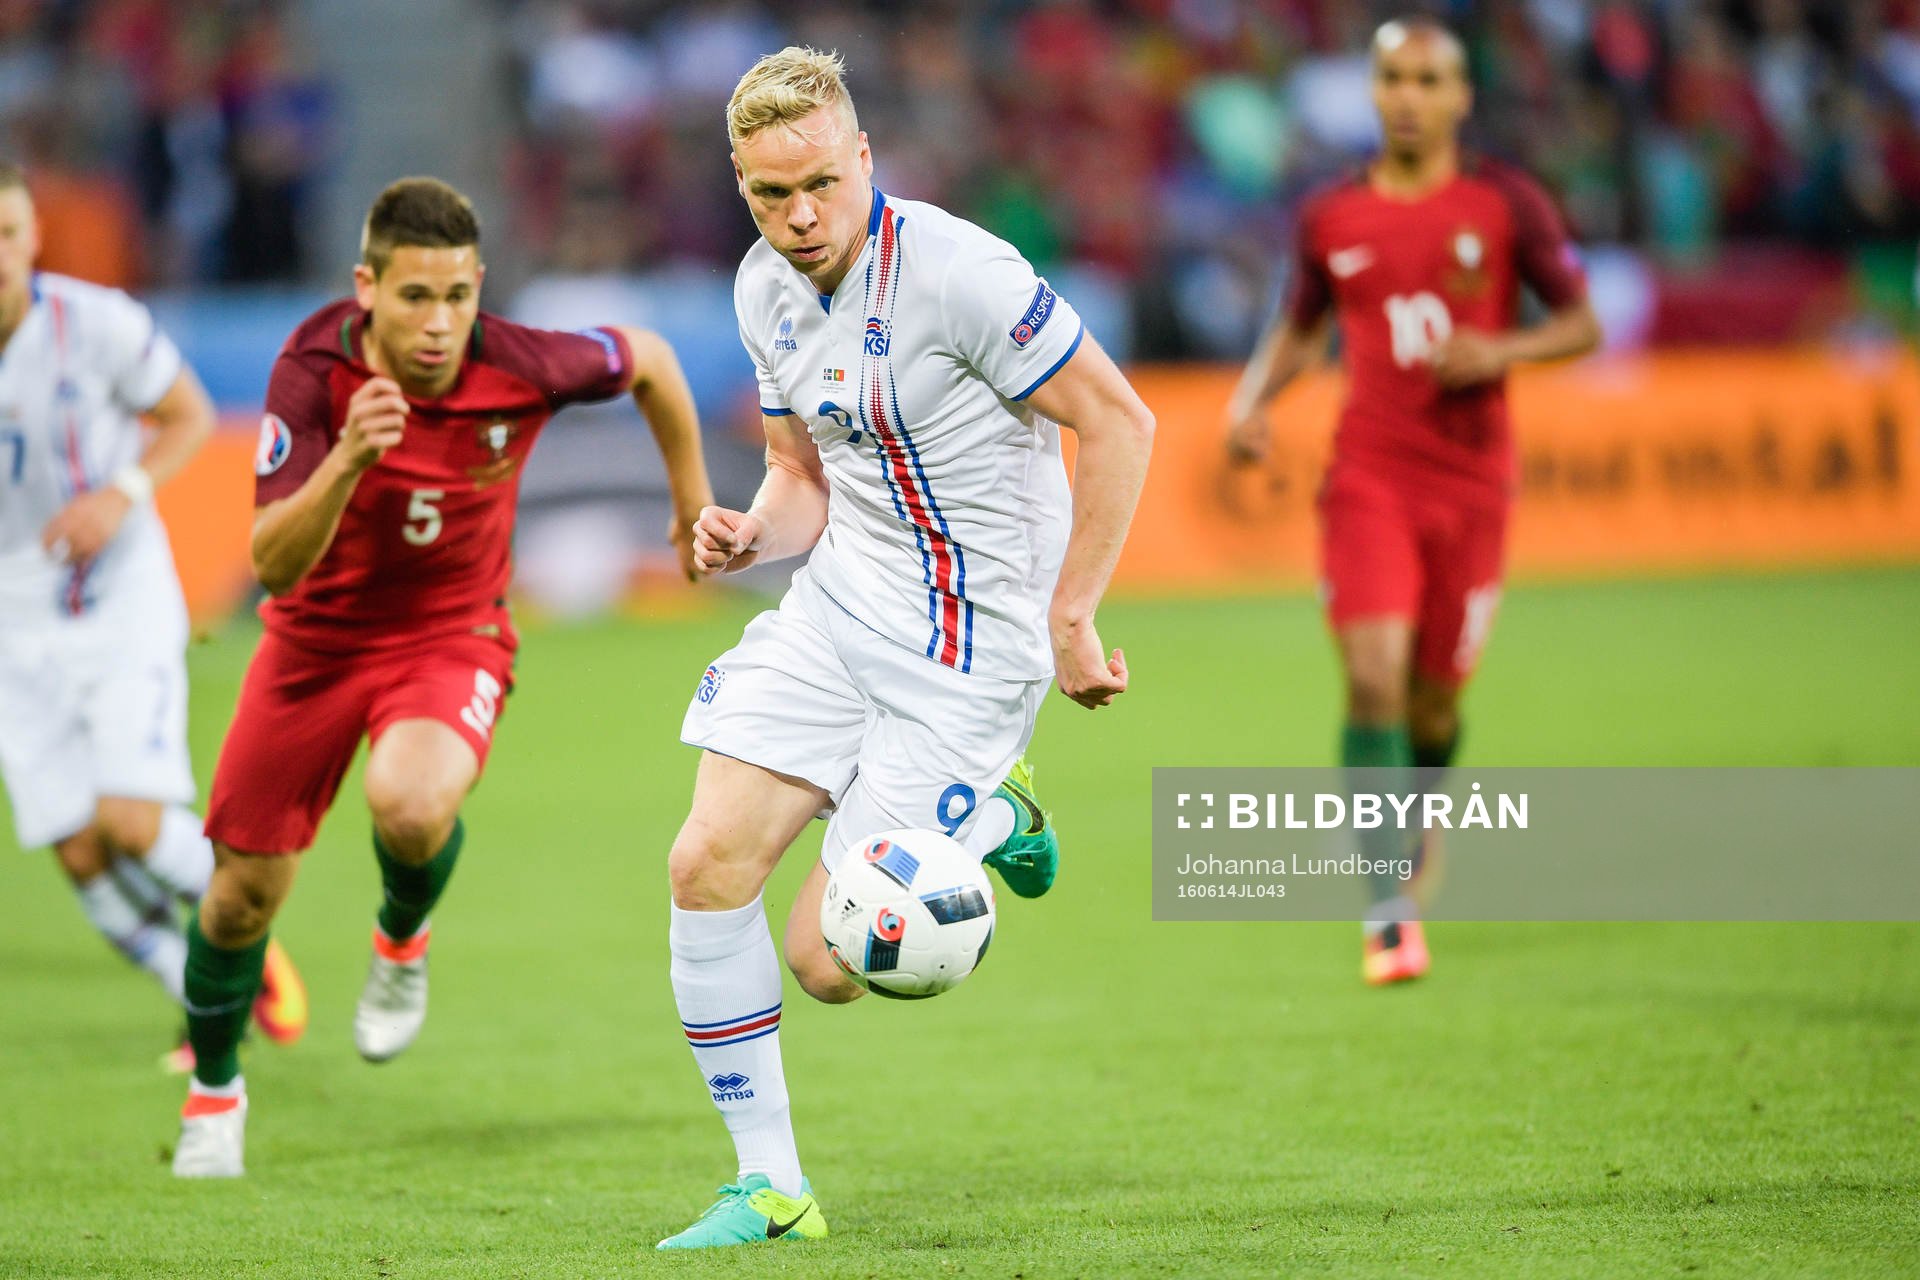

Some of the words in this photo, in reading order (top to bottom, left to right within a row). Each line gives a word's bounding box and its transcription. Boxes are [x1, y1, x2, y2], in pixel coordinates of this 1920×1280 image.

[1384, 291, 1453, 368] 10
[403, 488, 444, 546] 5
[937, 783, 976, 837] 9
